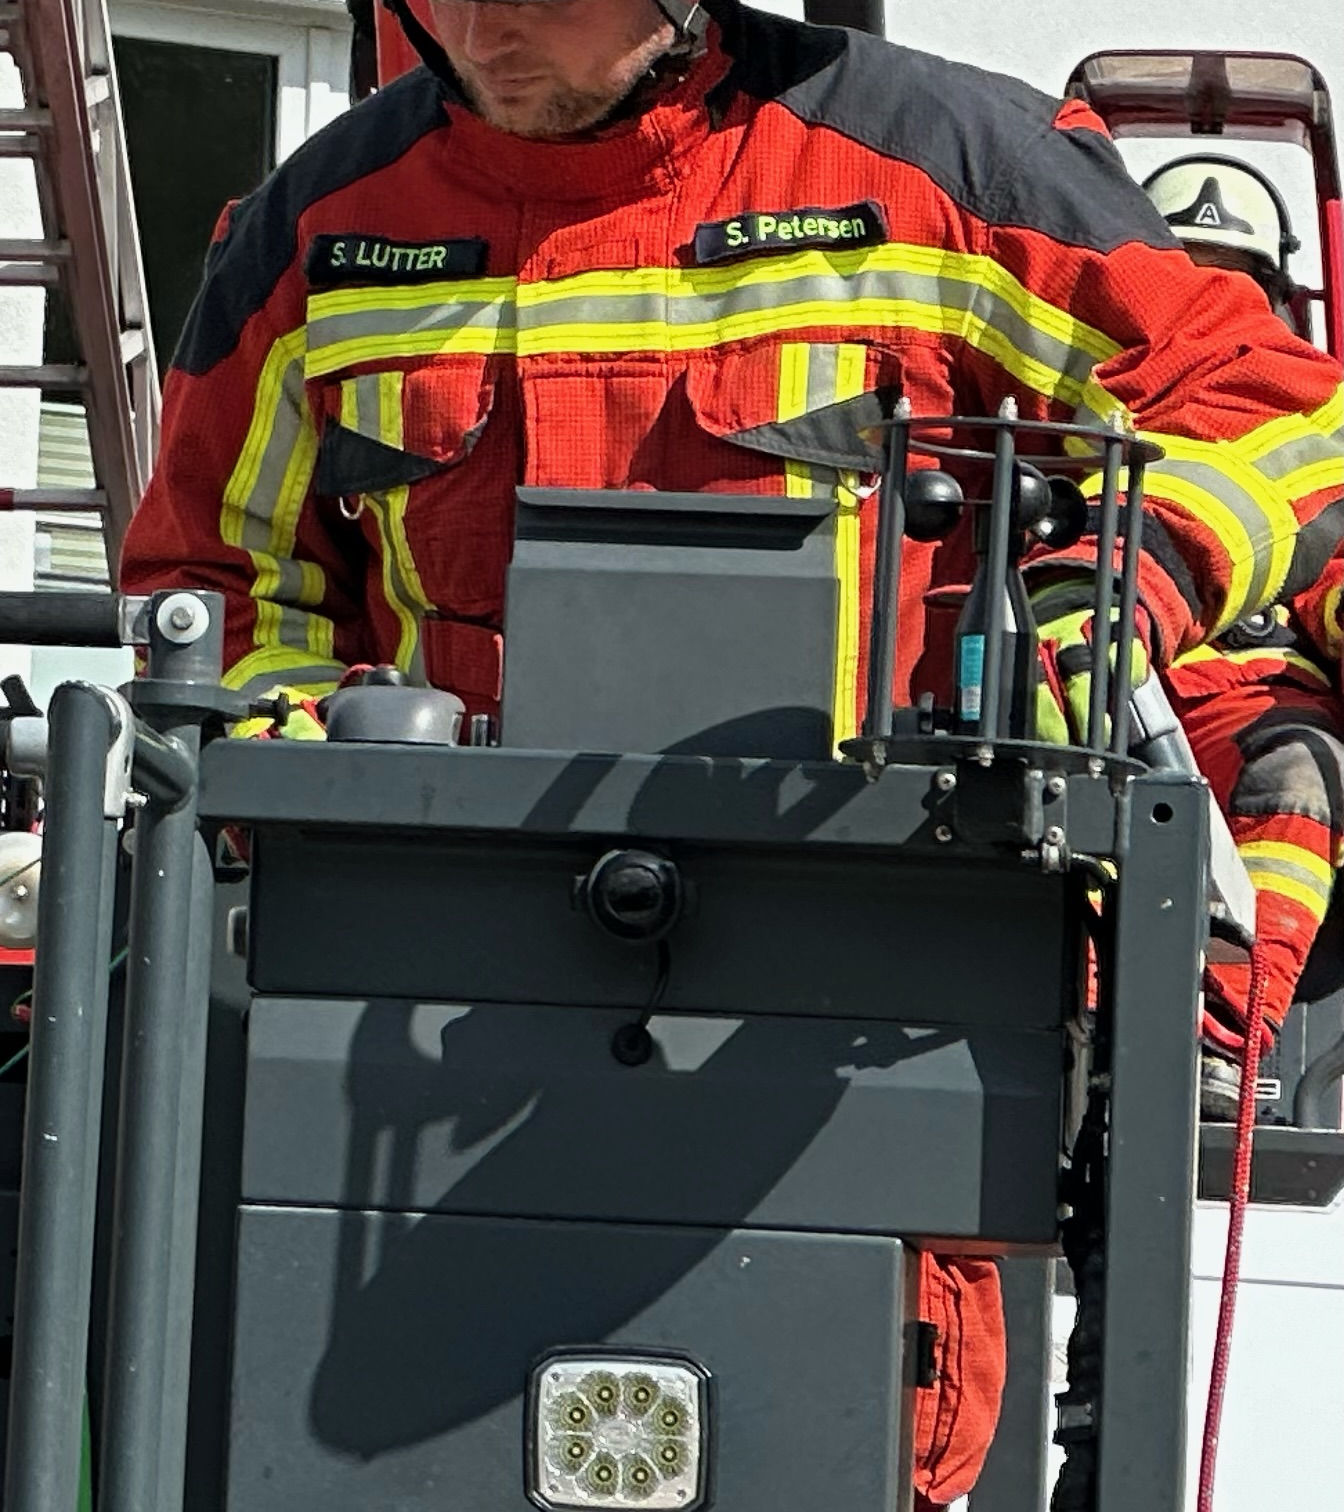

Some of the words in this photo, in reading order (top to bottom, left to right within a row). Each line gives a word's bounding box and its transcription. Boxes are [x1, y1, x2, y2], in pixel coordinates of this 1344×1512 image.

[1194, 202, 1222, 225] A
[726, 221, 749, 247] S.
[757, 215, 865, 241] Petersen
[356, 241, 448, 272] LUTTER
